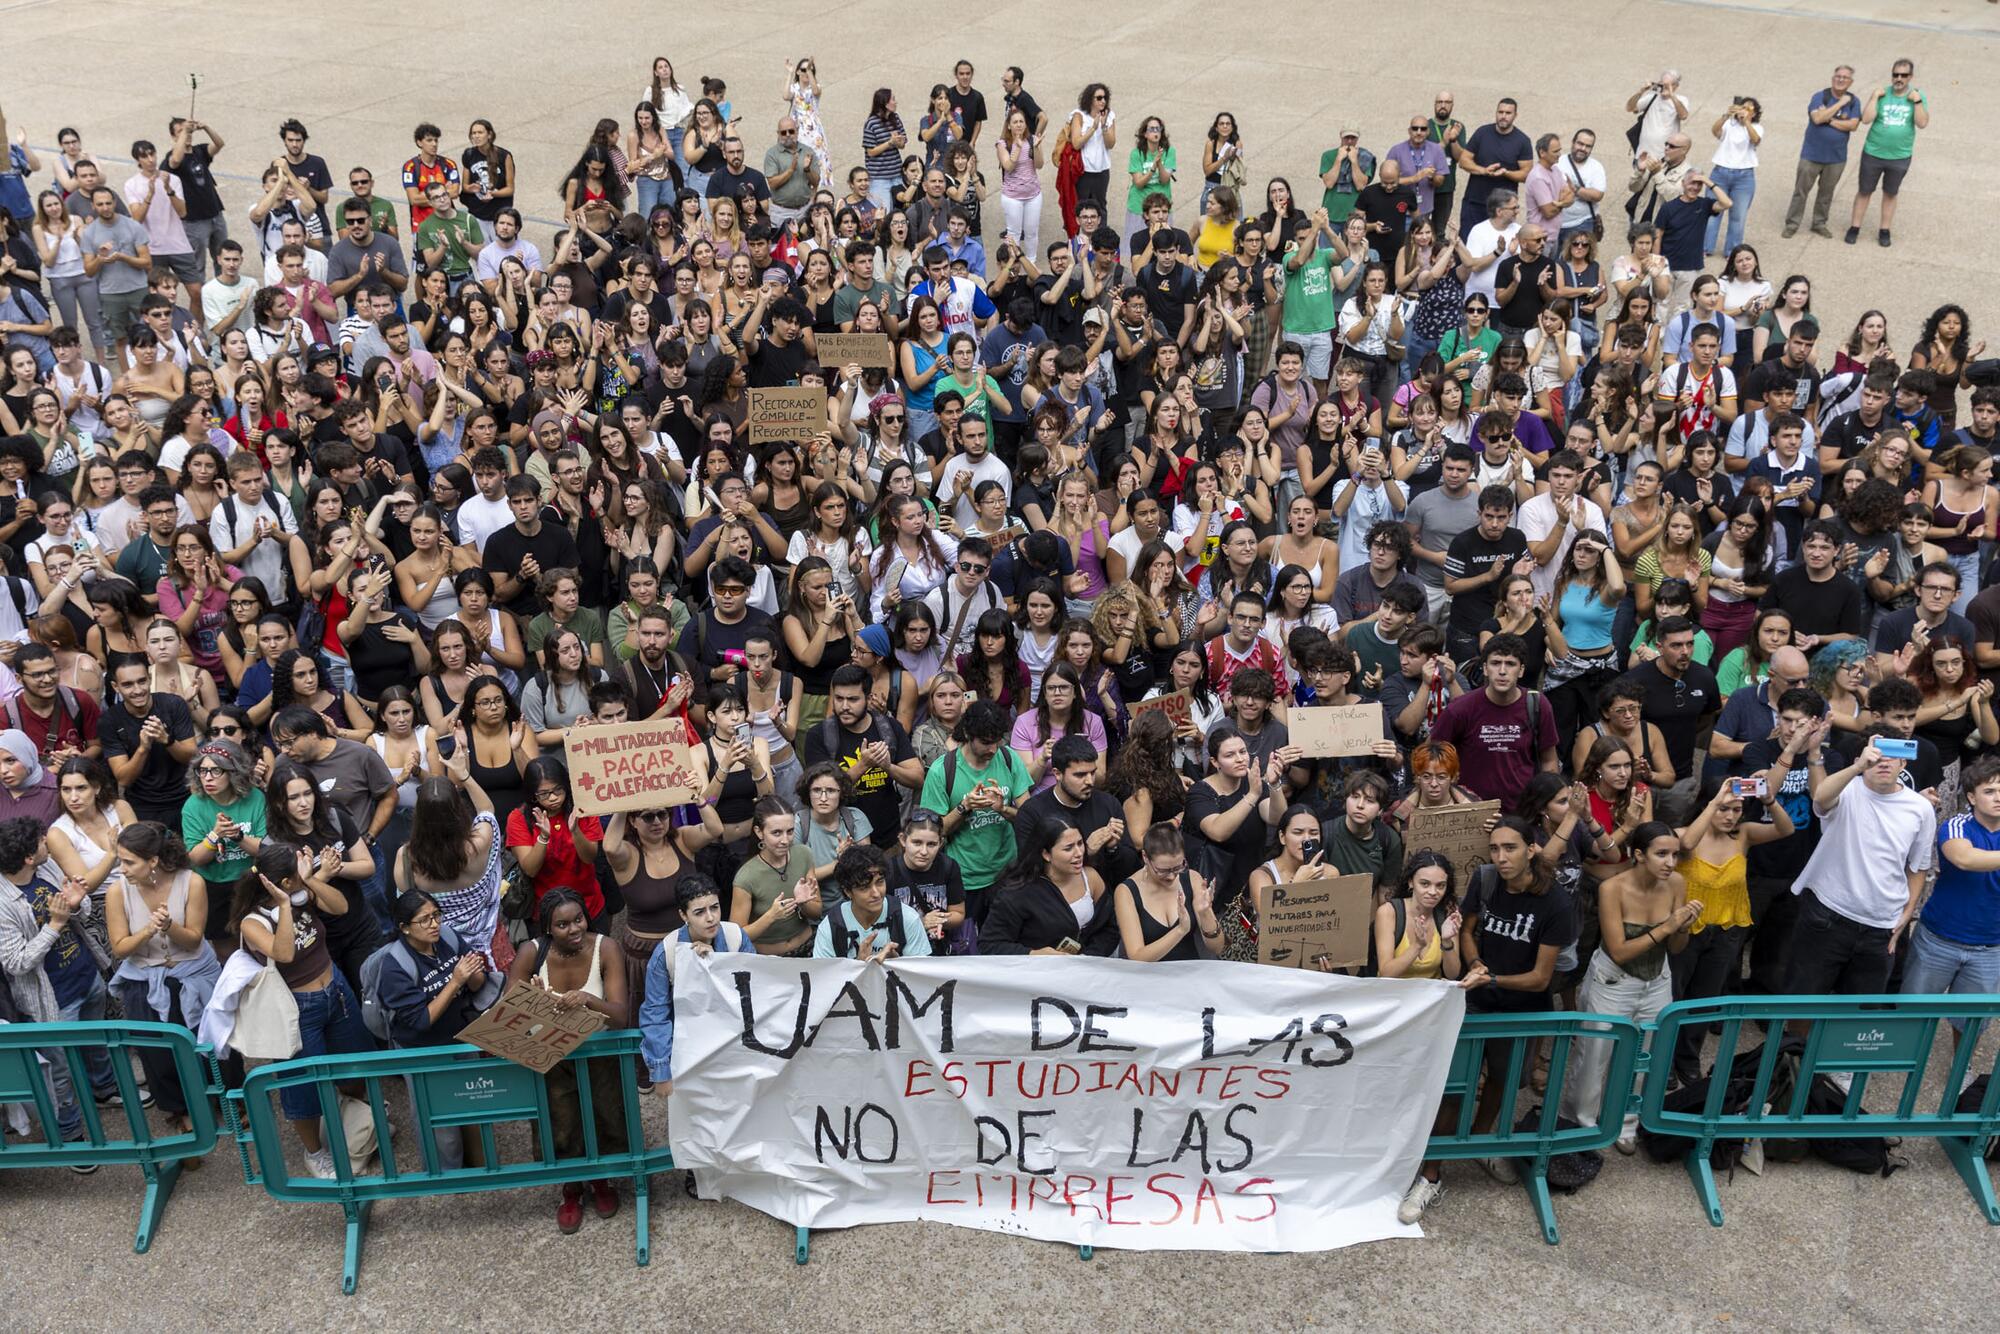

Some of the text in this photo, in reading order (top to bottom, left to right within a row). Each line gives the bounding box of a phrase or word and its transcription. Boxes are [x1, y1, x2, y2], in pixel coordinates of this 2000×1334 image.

[753, 425, 813, 438] RECORTES
[603, 749, 675, 778] PAGAR
[733, 969, 1354, 1068] UAM DE LAS
[1857, 1031, 1885, 1041] UAM
[465, 1079, 494, 1090] UAM
[904, 1060, 1292, 1100] ESTUDIANTES
[815, 1102, 1258, 1174] NO DE LAS
[926, 1170, 1277, 1226] EMPRESAS
